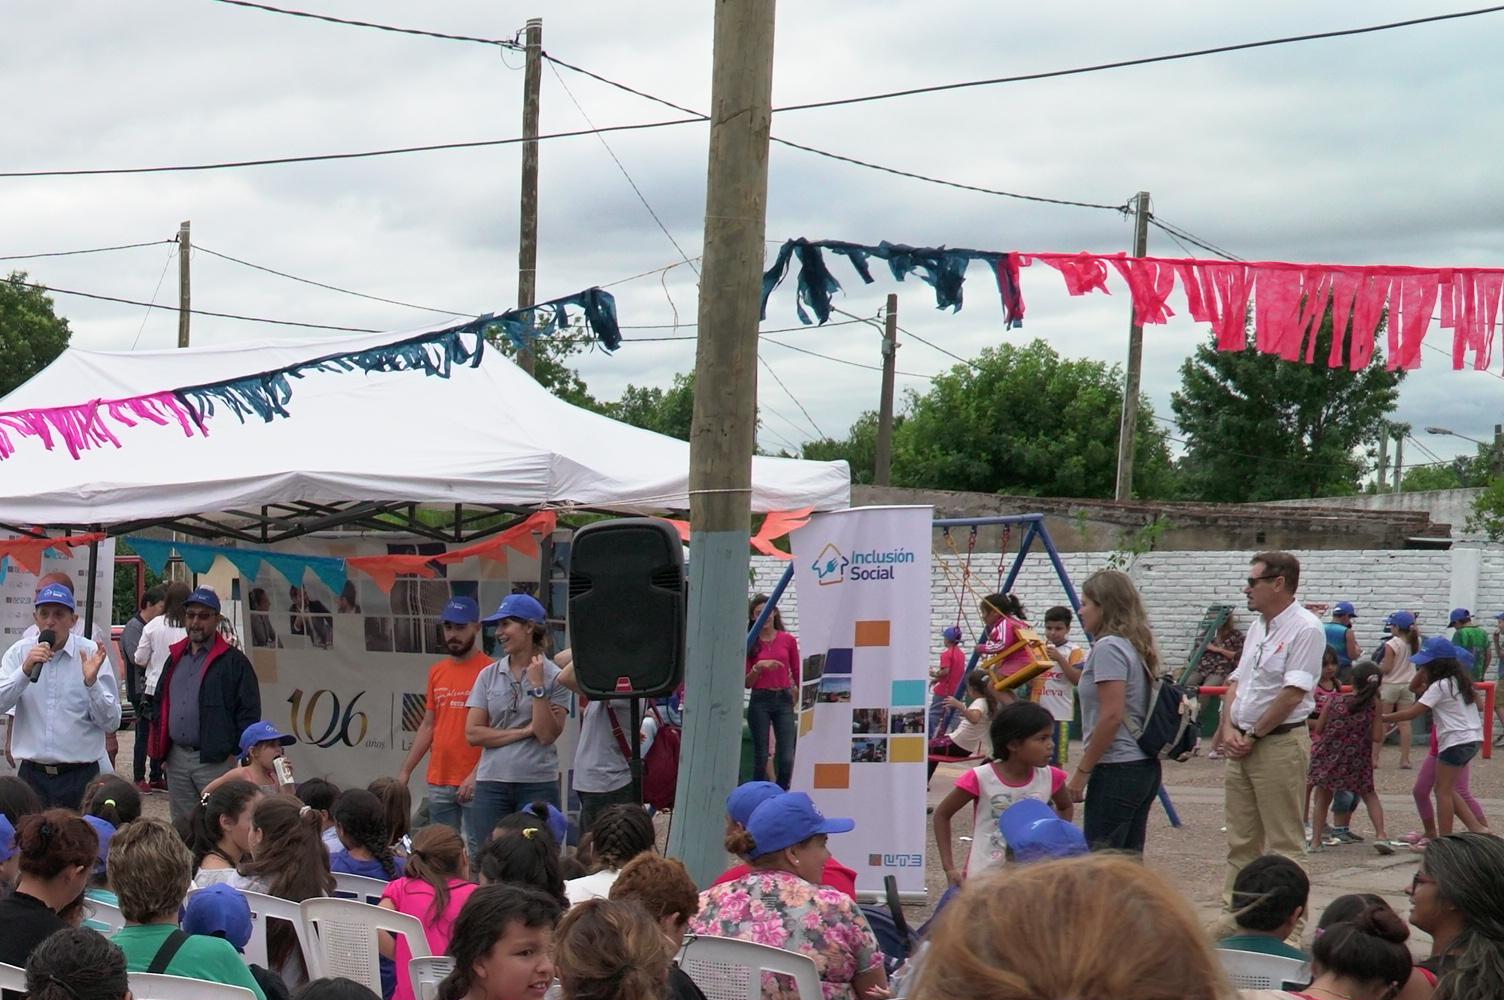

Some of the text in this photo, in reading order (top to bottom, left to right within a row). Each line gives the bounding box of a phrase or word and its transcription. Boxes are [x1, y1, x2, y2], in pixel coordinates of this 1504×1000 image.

[851, 547, 915, 565] Inclusión
[850, 564, 895, 581] Social
[286, 688, 369, 748] 106
